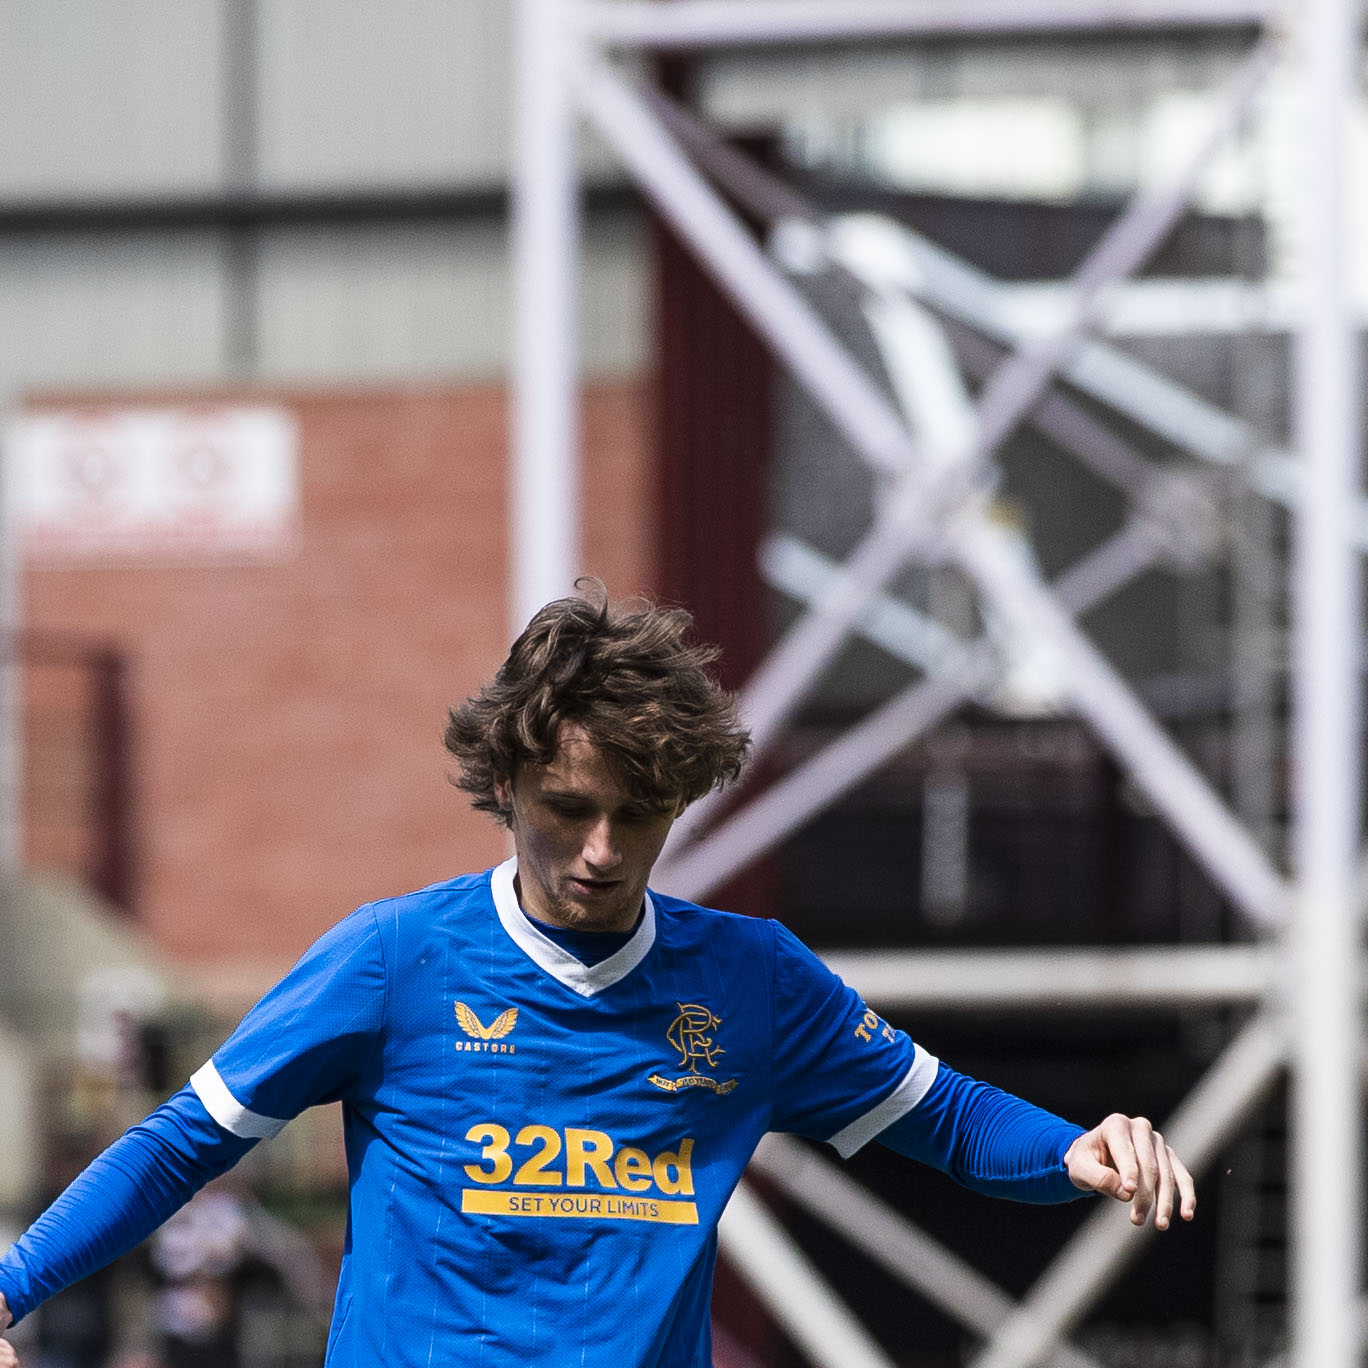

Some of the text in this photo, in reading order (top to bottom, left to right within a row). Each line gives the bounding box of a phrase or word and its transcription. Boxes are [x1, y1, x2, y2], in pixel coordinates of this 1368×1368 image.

[463, 1123, 695, 1196] 32Red
[509, 1196, 659, 1217] SET YOUR LIMITS
